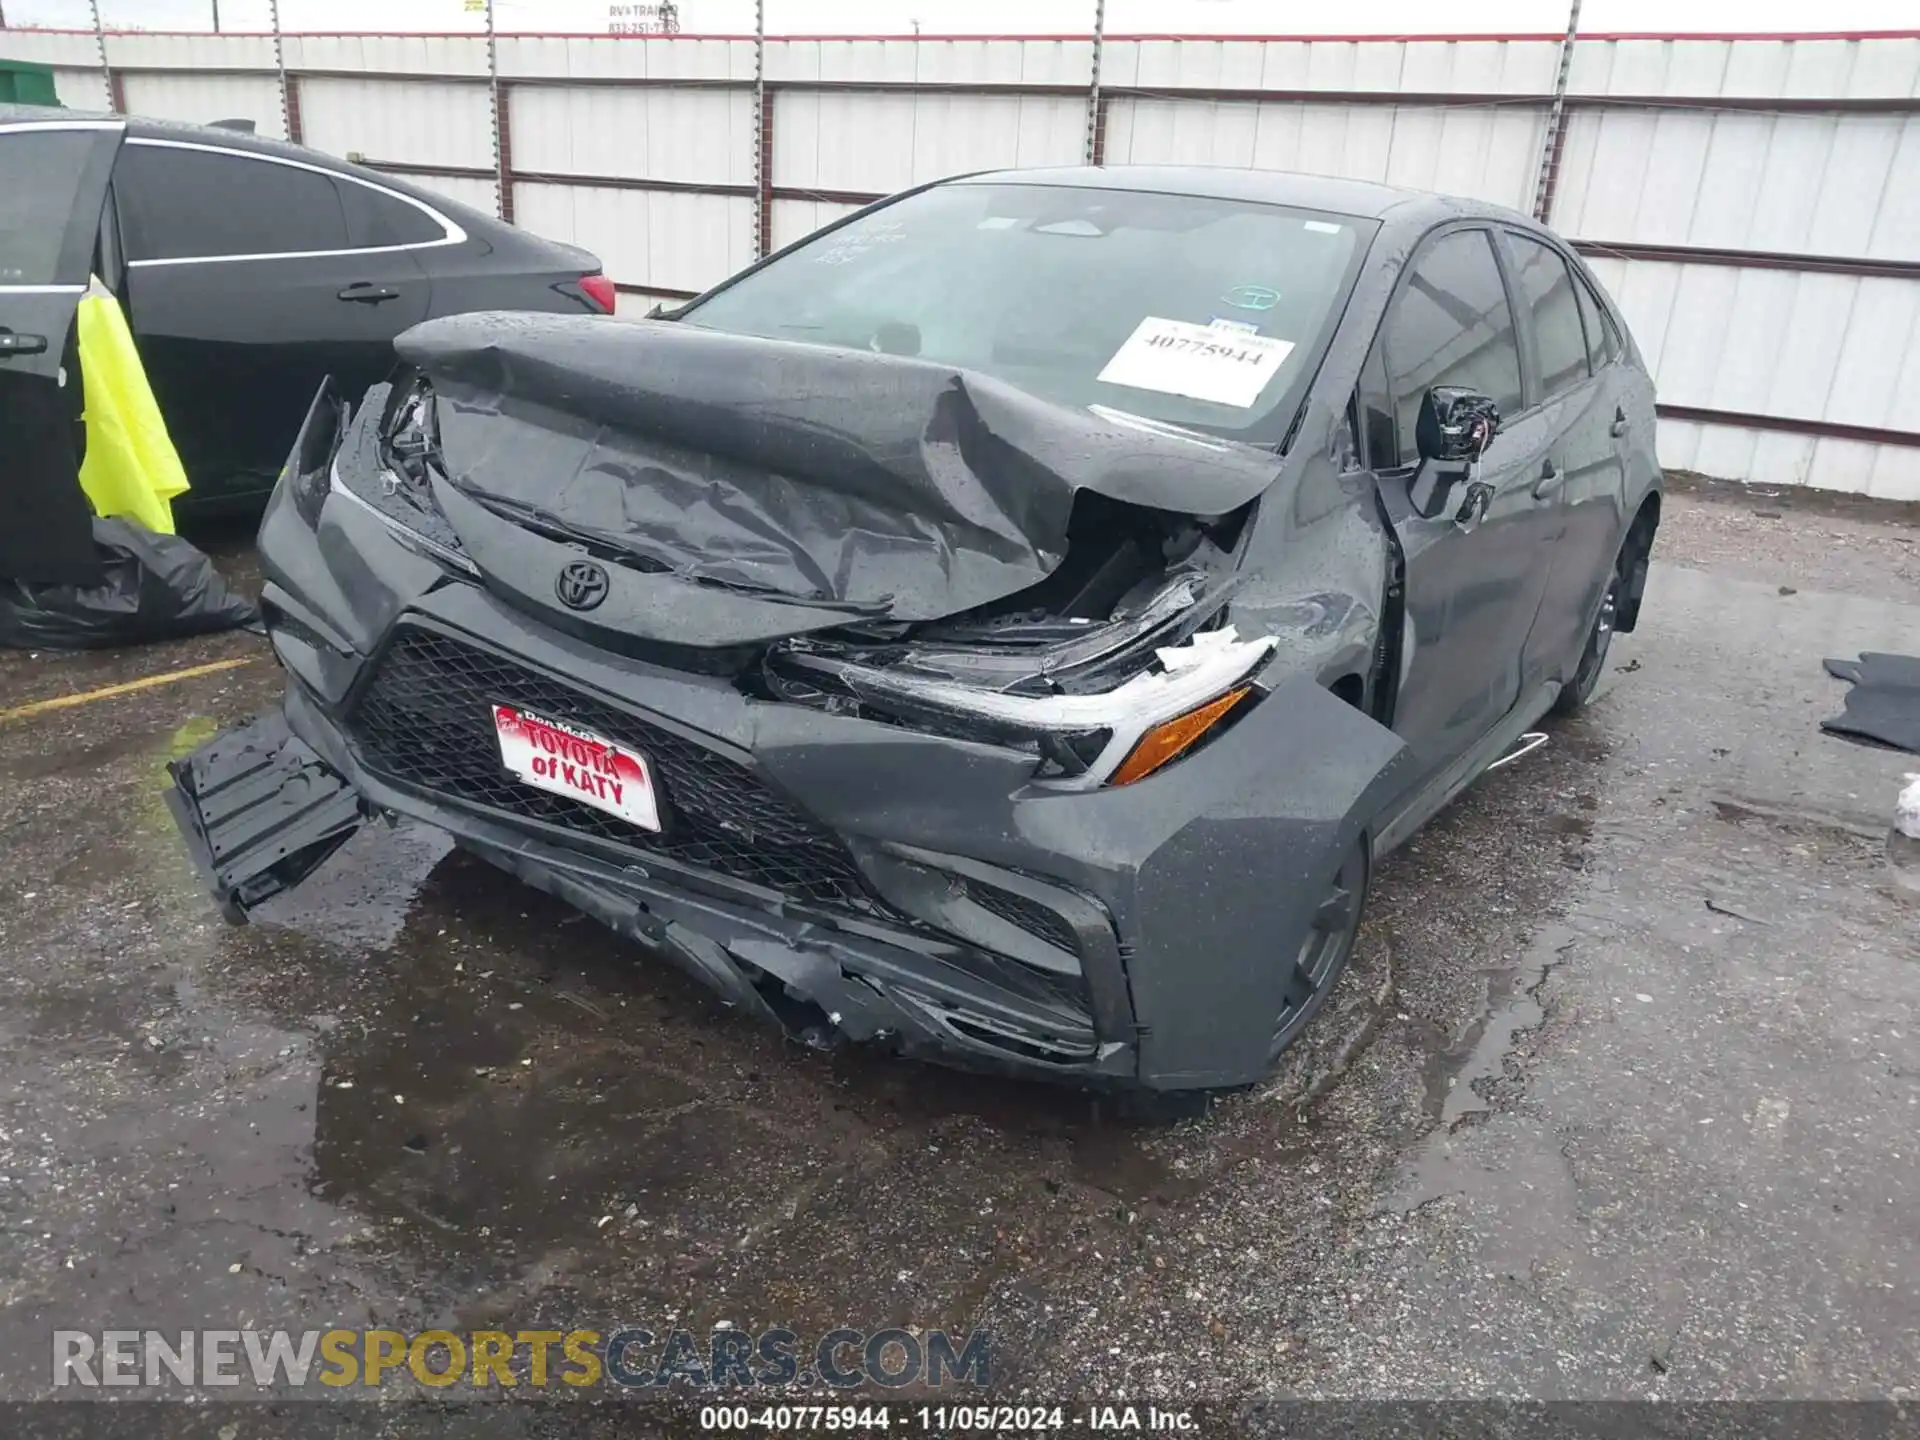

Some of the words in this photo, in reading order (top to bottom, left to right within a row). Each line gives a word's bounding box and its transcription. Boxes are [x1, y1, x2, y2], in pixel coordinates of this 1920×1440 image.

[1143, 334, 1264, 366] 40775944
[522, 721, 621, 780] TOYOTA
[531, 756, 558, 781] of
[561, 761, 624, 806] KATY
